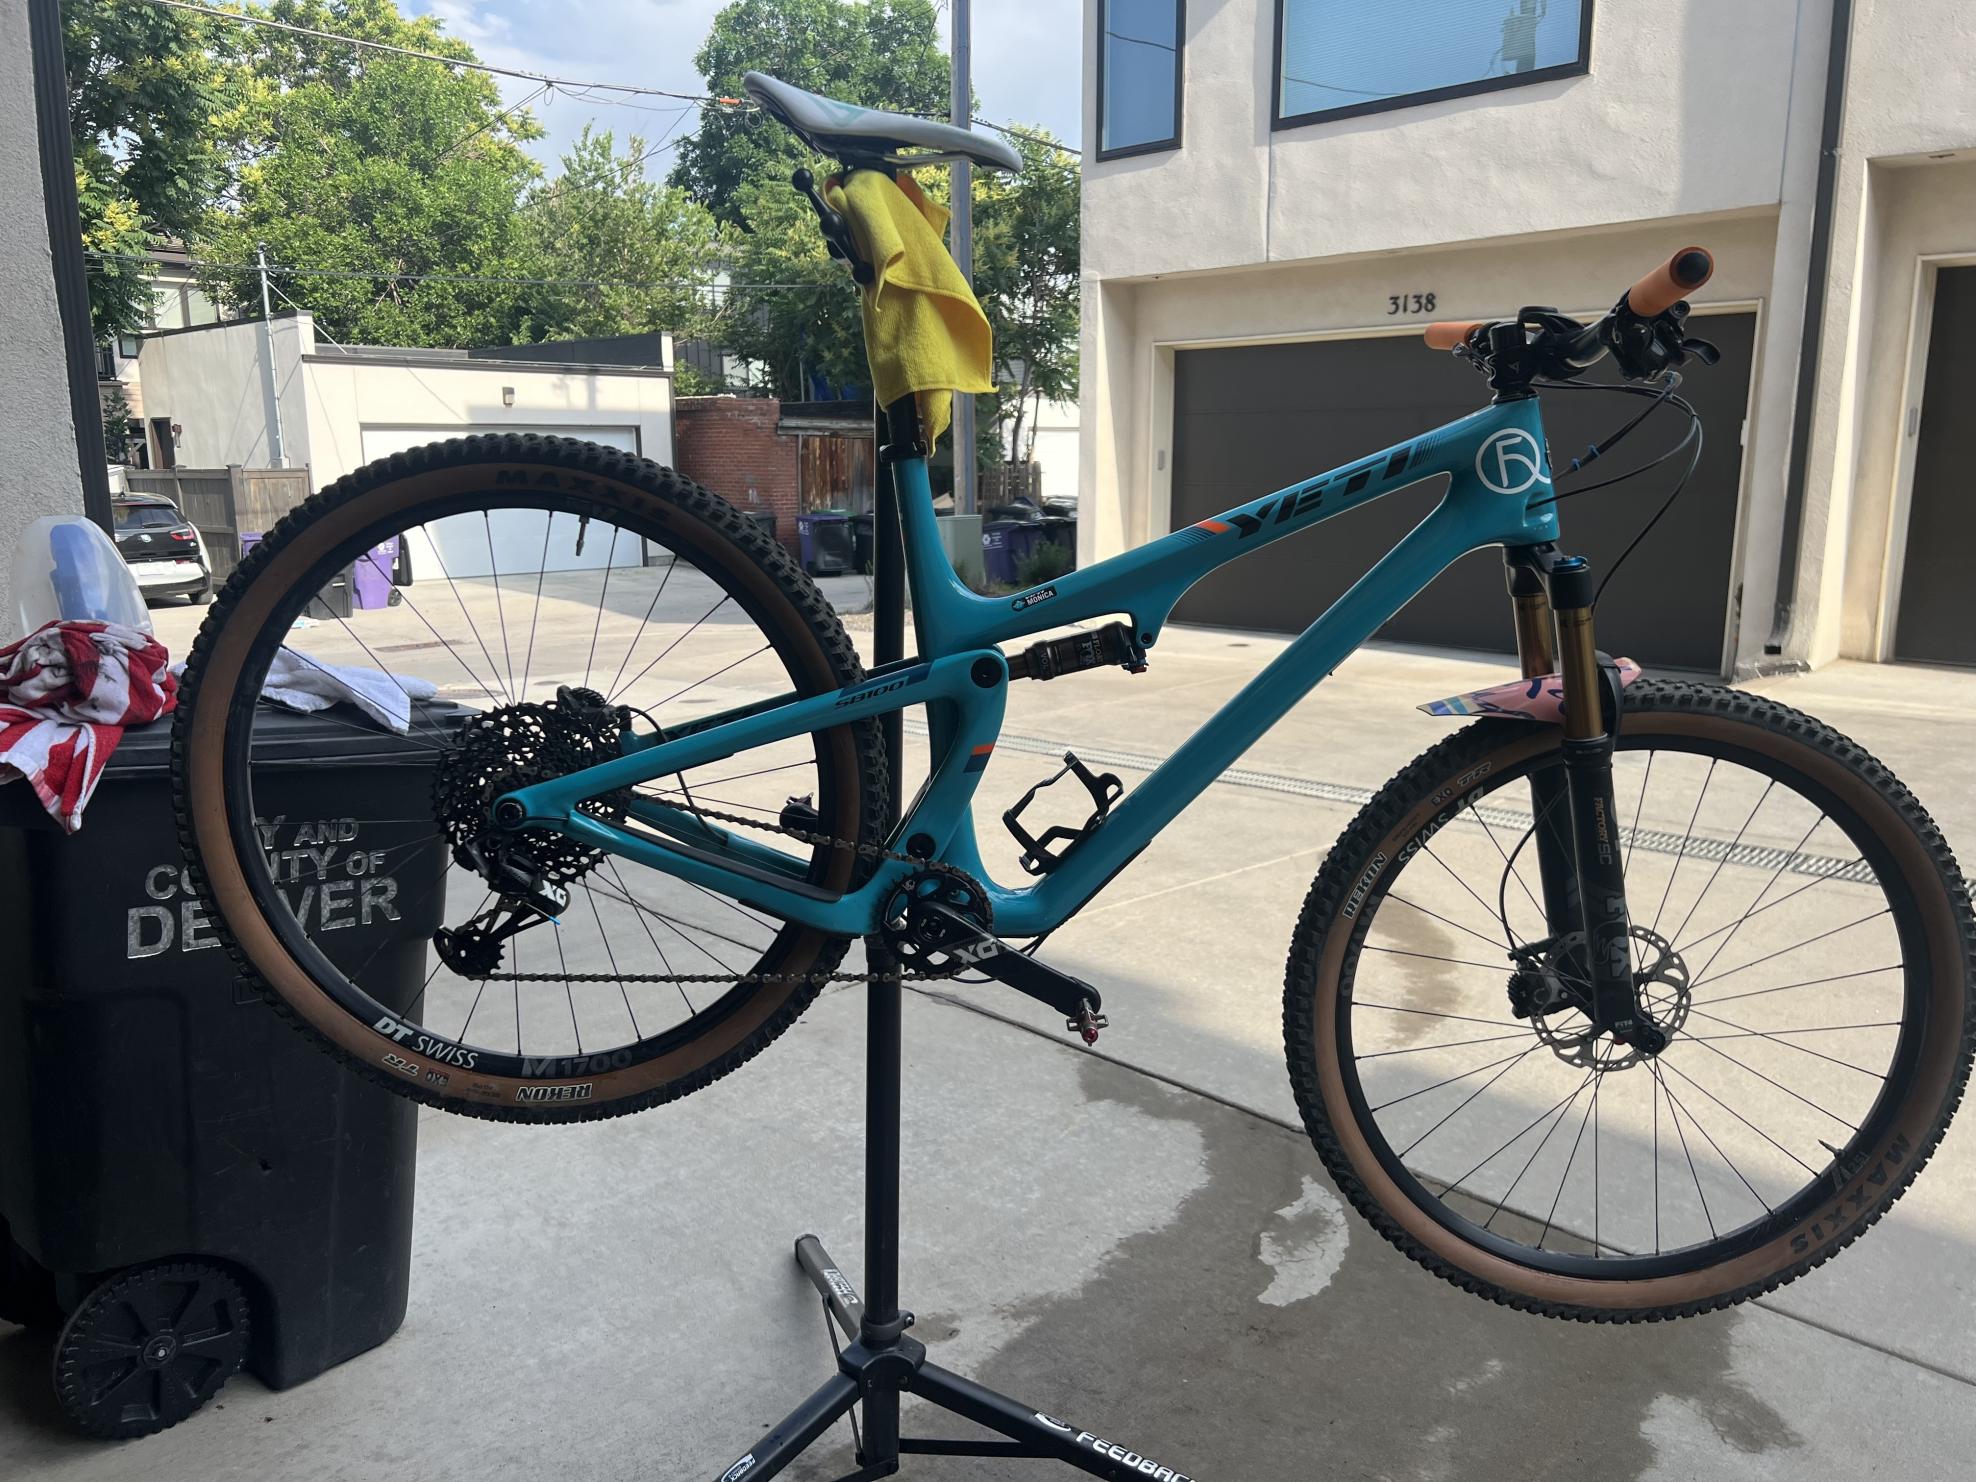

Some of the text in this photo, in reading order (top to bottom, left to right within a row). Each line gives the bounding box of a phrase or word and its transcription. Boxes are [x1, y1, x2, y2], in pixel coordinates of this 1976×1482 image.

[1387, 292, 1436, 315] 3138
[1226, 445, 1414, 540] YETI
[834, 680, 905, 708] SB100
[293, 816, 360, 847] AND
[1398, 811, 1450, 865] SWISS
[144, 846, 387, 900] CTY OF
[1342, 851, 1388, 919] REKON
[127, 876, 401, 960] DEVER
[373, 1016, 479, 1070] DT SWISS
[515, 1083, 593, 1102] REKON
[1075, 1430, 1198, 1482] FEEDBAC
